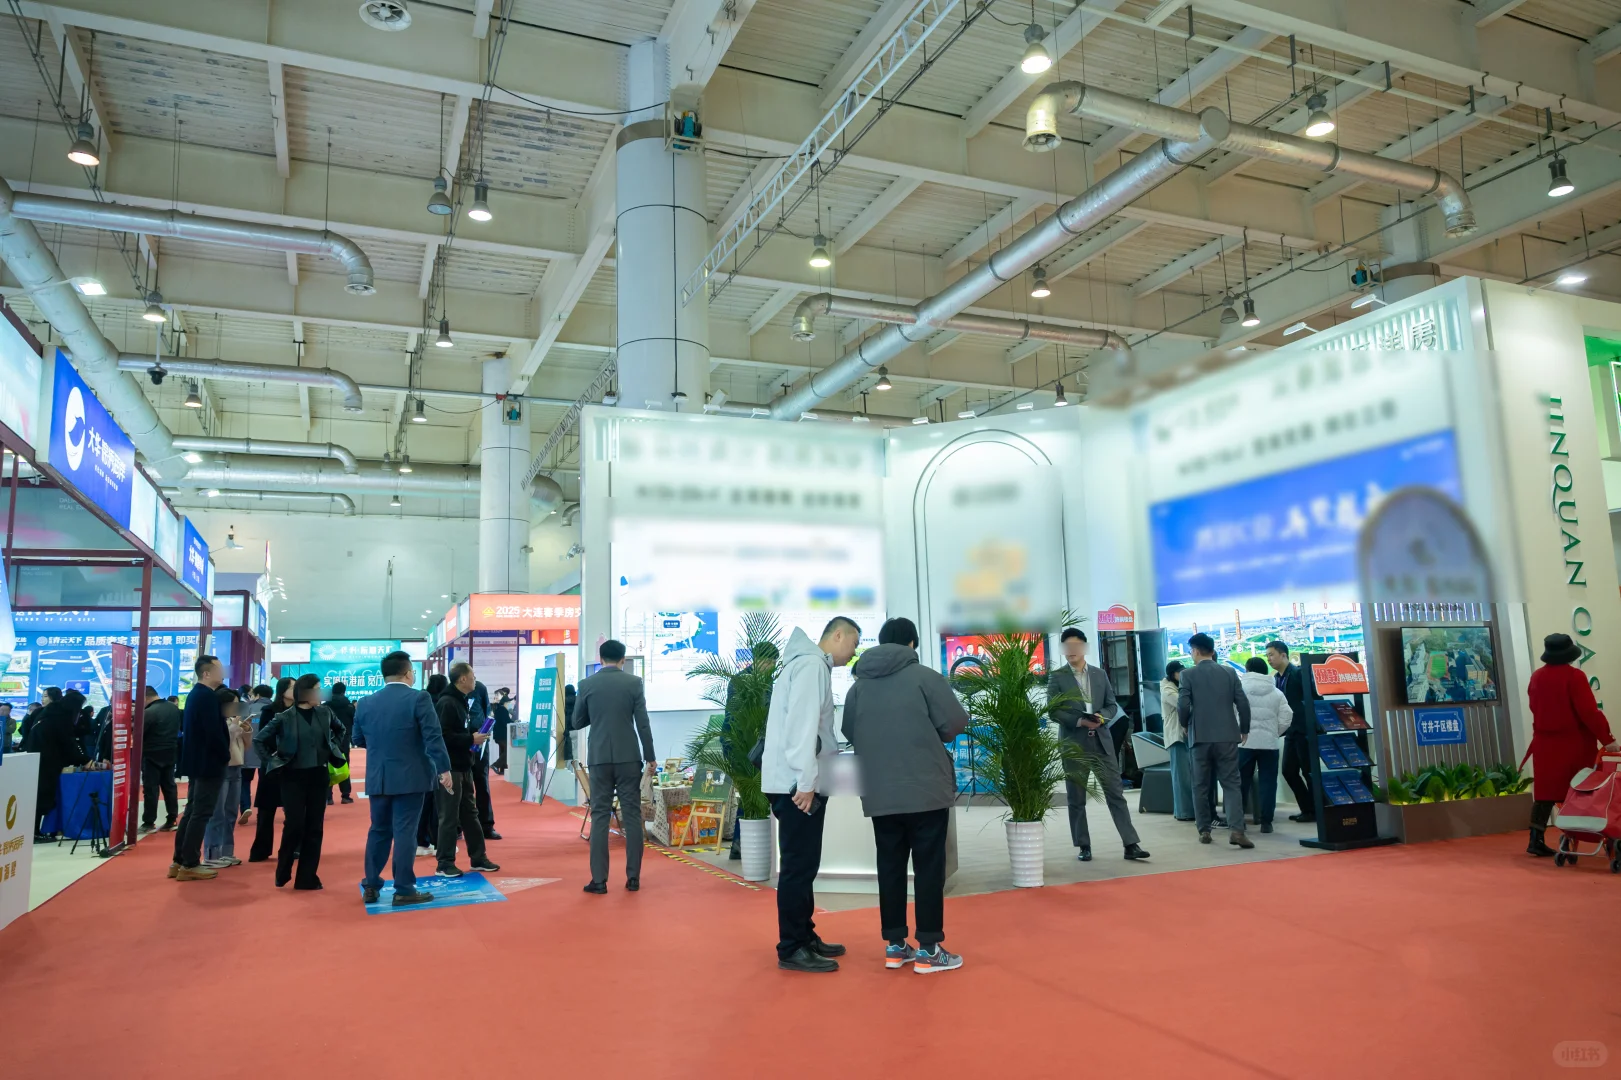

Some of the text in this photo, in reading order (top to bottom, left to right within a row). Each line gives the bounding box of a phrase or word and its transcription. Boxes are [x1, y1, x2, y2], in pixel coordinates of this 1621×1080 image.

[495, 606, 520, 615] 2025
[130, 636, 172, 646] 现实景
[1421, 719, 1460, 733] 甘井子区楼盘
